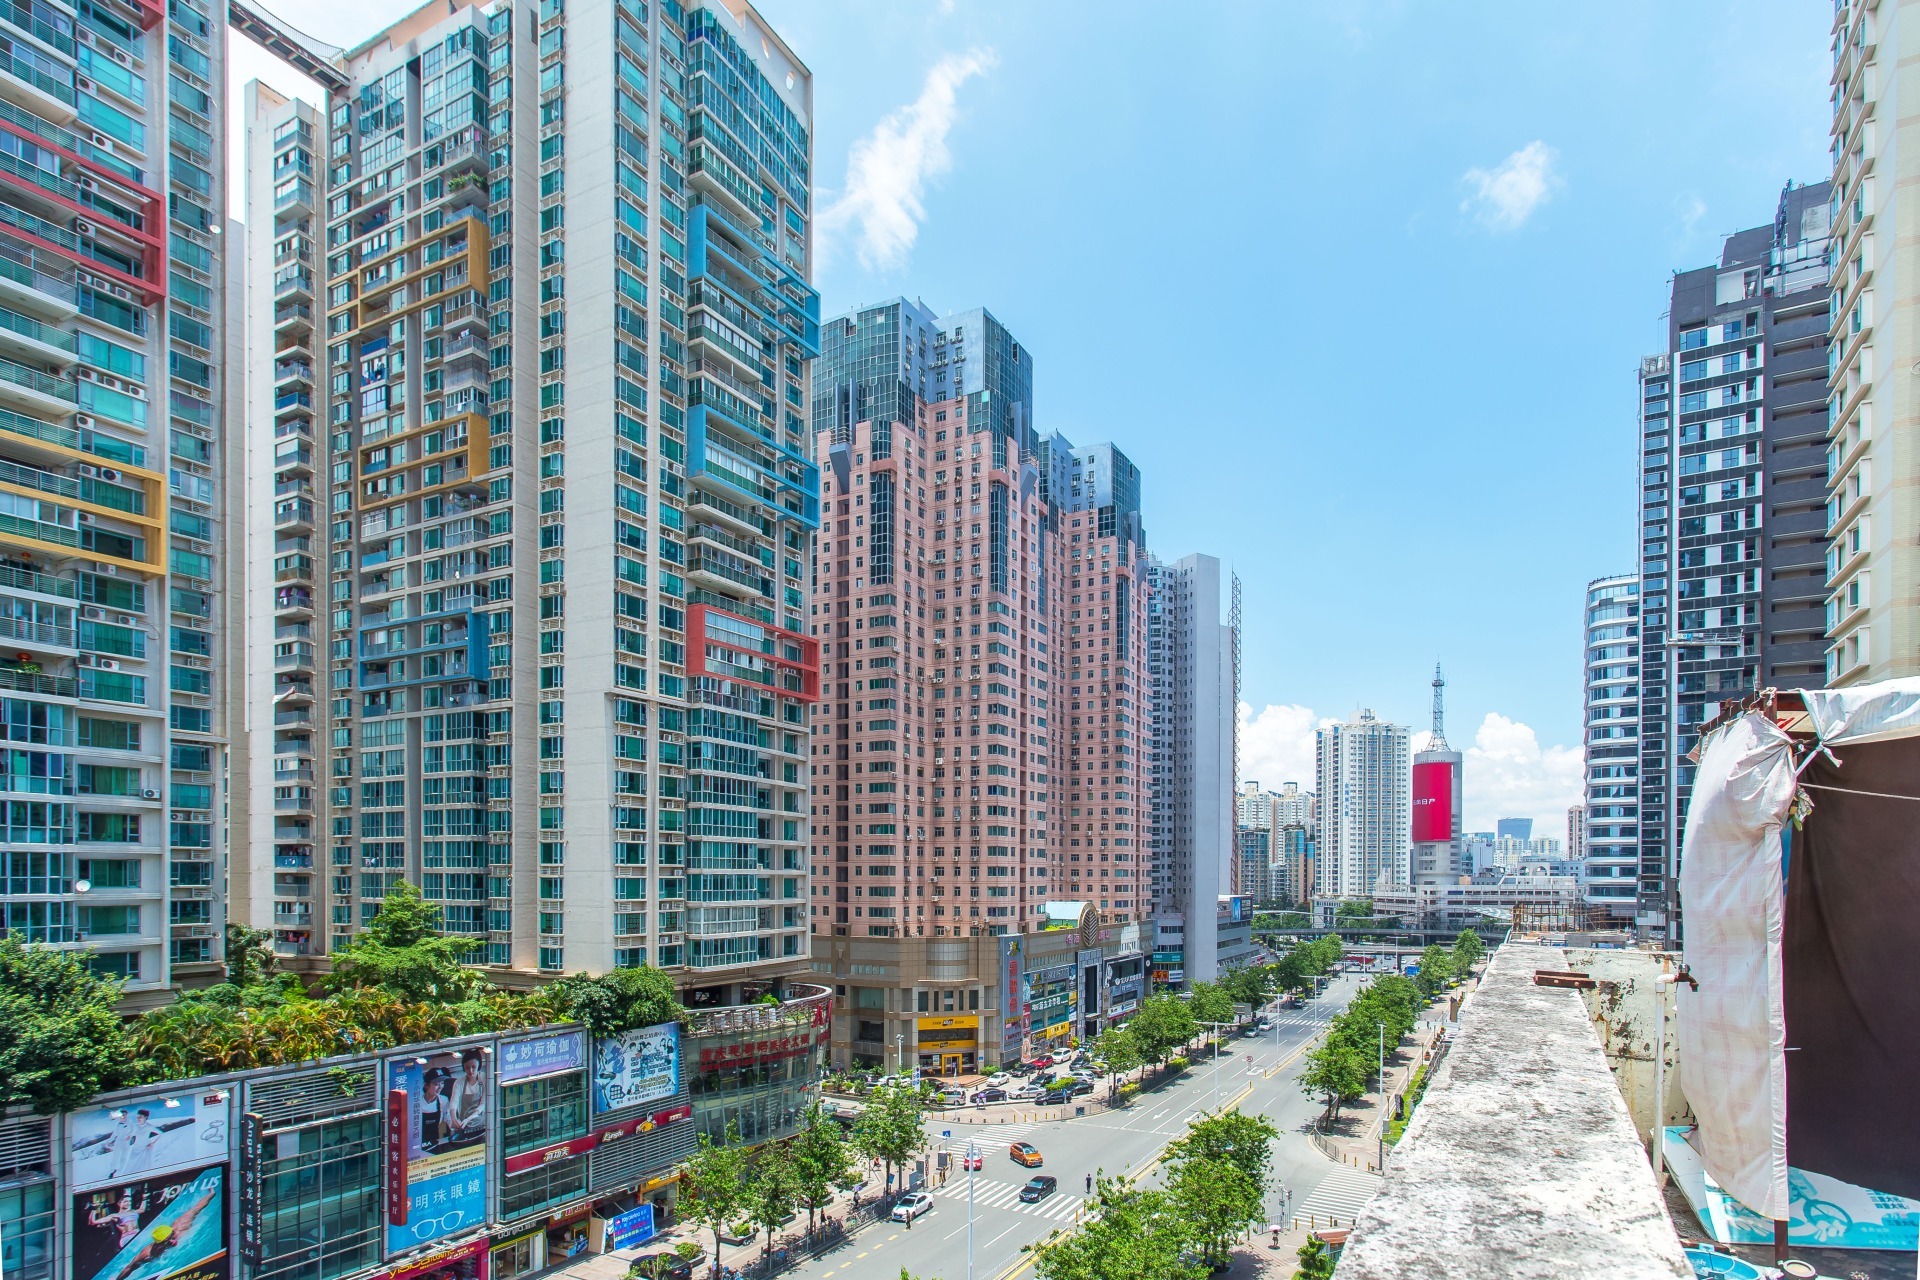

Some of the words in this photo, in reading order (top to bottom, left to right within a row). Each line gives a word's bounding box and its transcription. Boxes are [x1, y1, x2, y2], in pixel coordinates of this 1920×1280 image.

[520, 1037, 570, 1060] 妙荷瑜伽
[391, 1117, 399, 1215] 必胜客欢乐餐厅
[153, 1181, 198, 1205] JOIN
[200, 1175, 222, 1191] US
[415, 1179, 481, 1211] 明珠眼鏡
